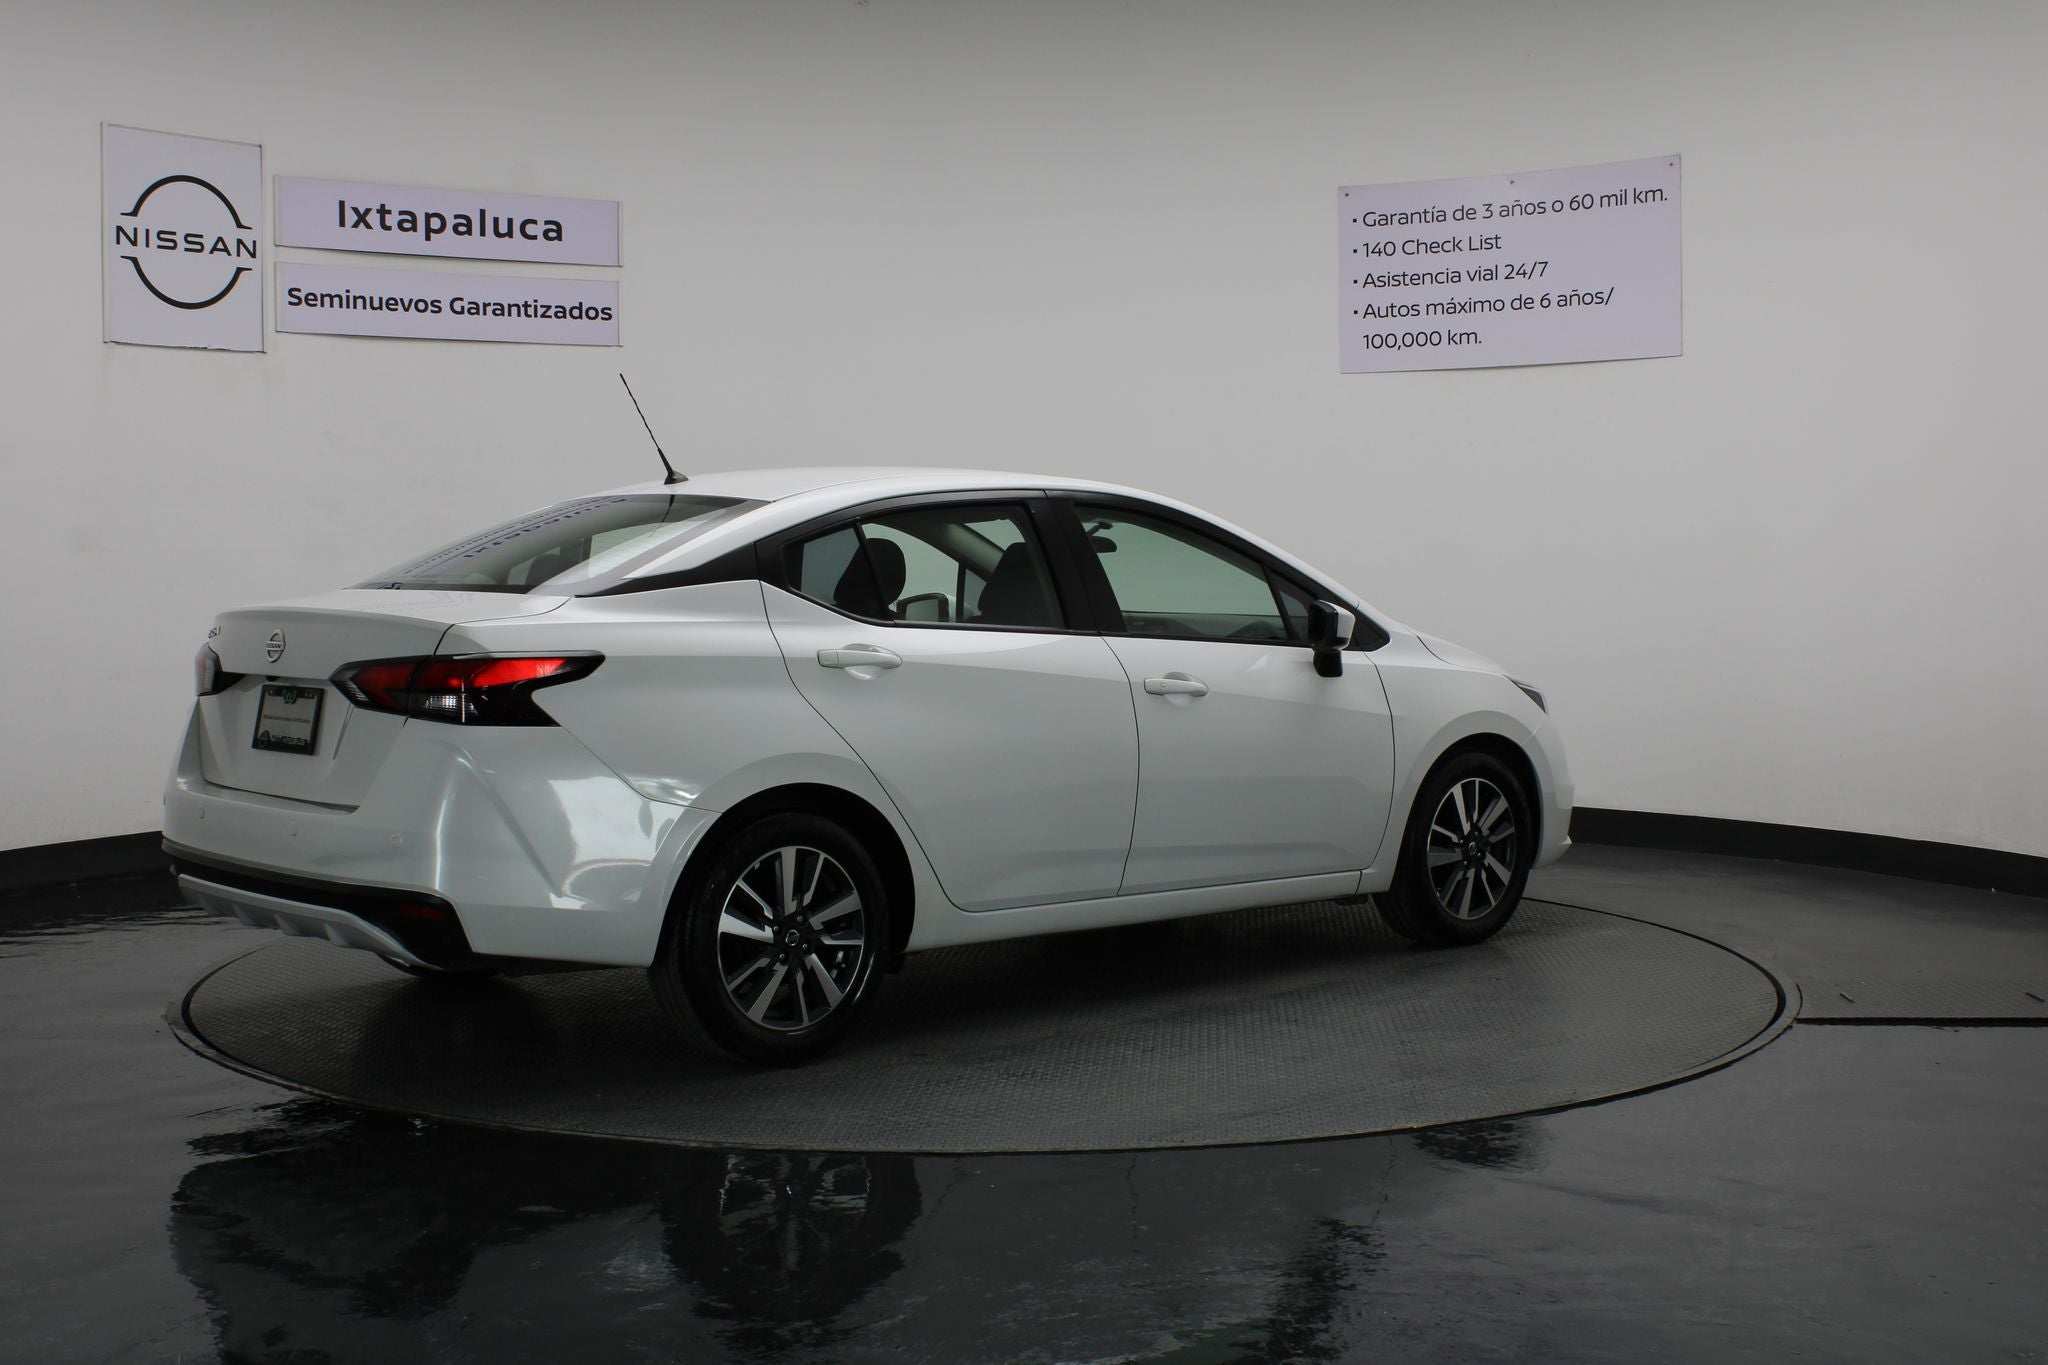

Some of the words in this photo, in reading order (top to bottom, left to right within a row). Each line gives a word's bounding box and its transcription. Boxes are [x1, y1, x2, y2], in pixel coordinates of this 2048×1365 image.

[338, 199, 563, 242] Ixtapaluca
[1362, 205, 1447, 228] Garantía
[1452, 204, 1477, 222] de
[1482, 203, 1494, 220] 3
[1498, 199, 1547, 218] años
[1551, 199, 1564, 213] o
[1569, 194, 1595, 212] 60
[1599, 188, 1628, 209] mil
[1633, 187, 1668, 205] km.
[115, 225, 257, 259] NISSAN
[1362, 240, 1397, 258] 140
[1401, 236, 1464, 256] Check
[1468, 233, 1503, 252] List
[1362, 265, 1462, 289] Asistencia
[1465, 263, 1499, 283] vial
[1503, 260, 1549, 281] 24/7
[287, 287, 443, 315] Seminuevos
[449, 296, 613, 322] Garantizados
[1362, 302, 1421, 320] Autos
[1425, 296, 1506, 317] máximo
[1510, 293, 1535, 311] de
[1539, 292, 1552, 309] 6
[1556, 286, 1615, 308] años/
[1362, 330, 1442, 351] 100,000
[1447, 328, 1482, 346] km.
